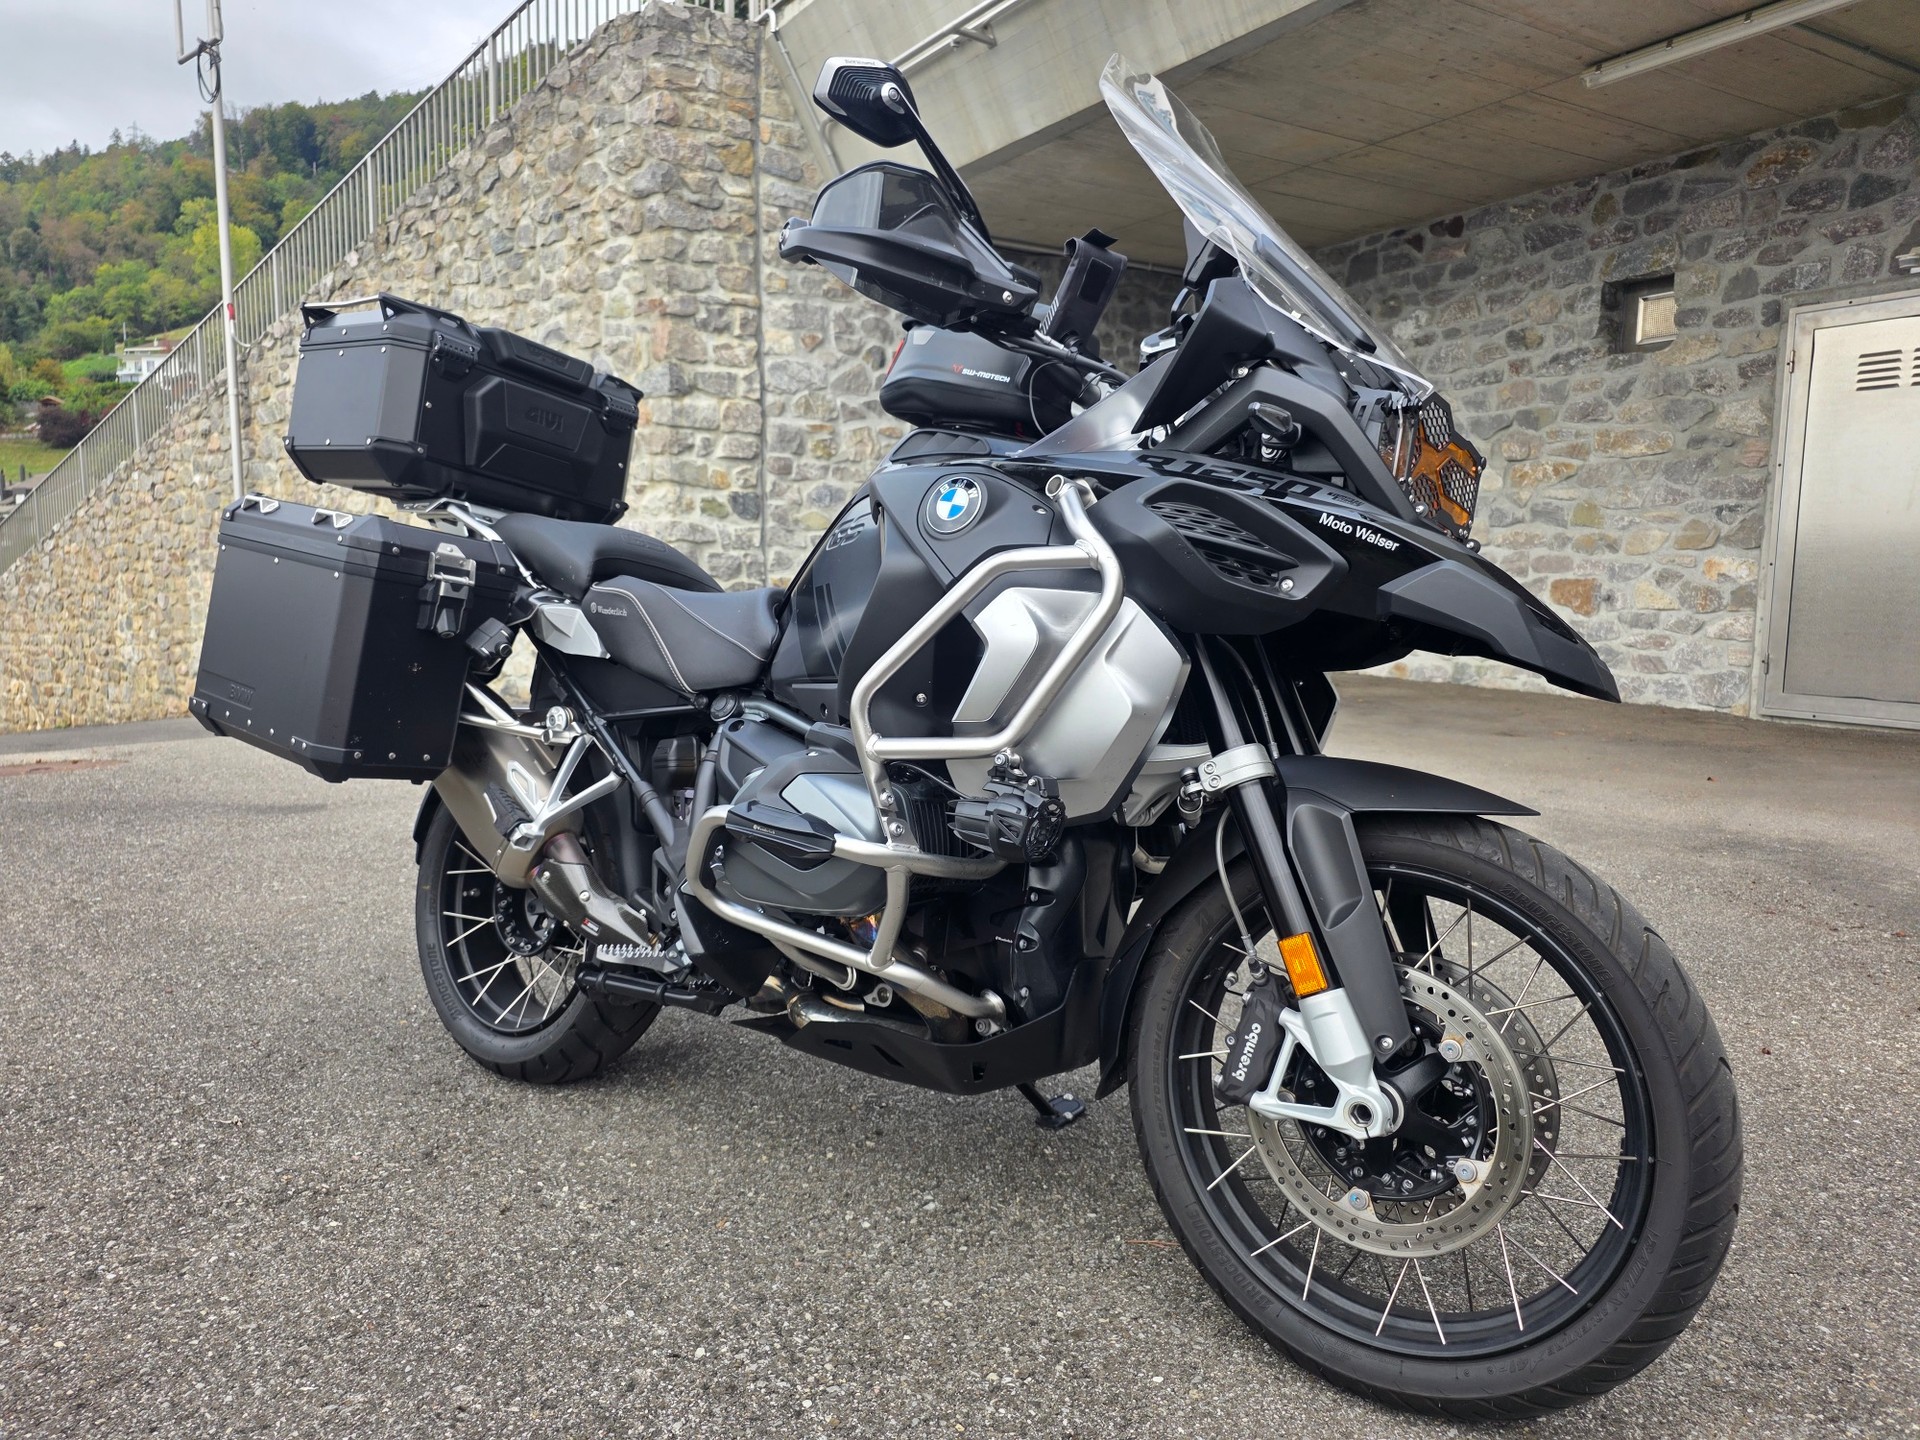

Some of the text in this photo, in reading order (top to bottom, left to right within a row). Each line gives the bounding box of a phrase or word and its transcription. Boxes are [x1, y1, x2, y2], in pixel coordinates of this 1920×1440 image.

[961, 368, 1011, 383] SW-MOTECH
[939, 479, 979, 498] BMW
[1318, 512, 1400, 551] Moto Walser
[1500, 883, 1614, 987] BRIDGESTONE
[425, 942, 464, 1020] BRIDGESTONE
[1231, 1022, 1262, 1082] brembo
[1185, 1204, 1275, 1311] BRIDGESTONE
